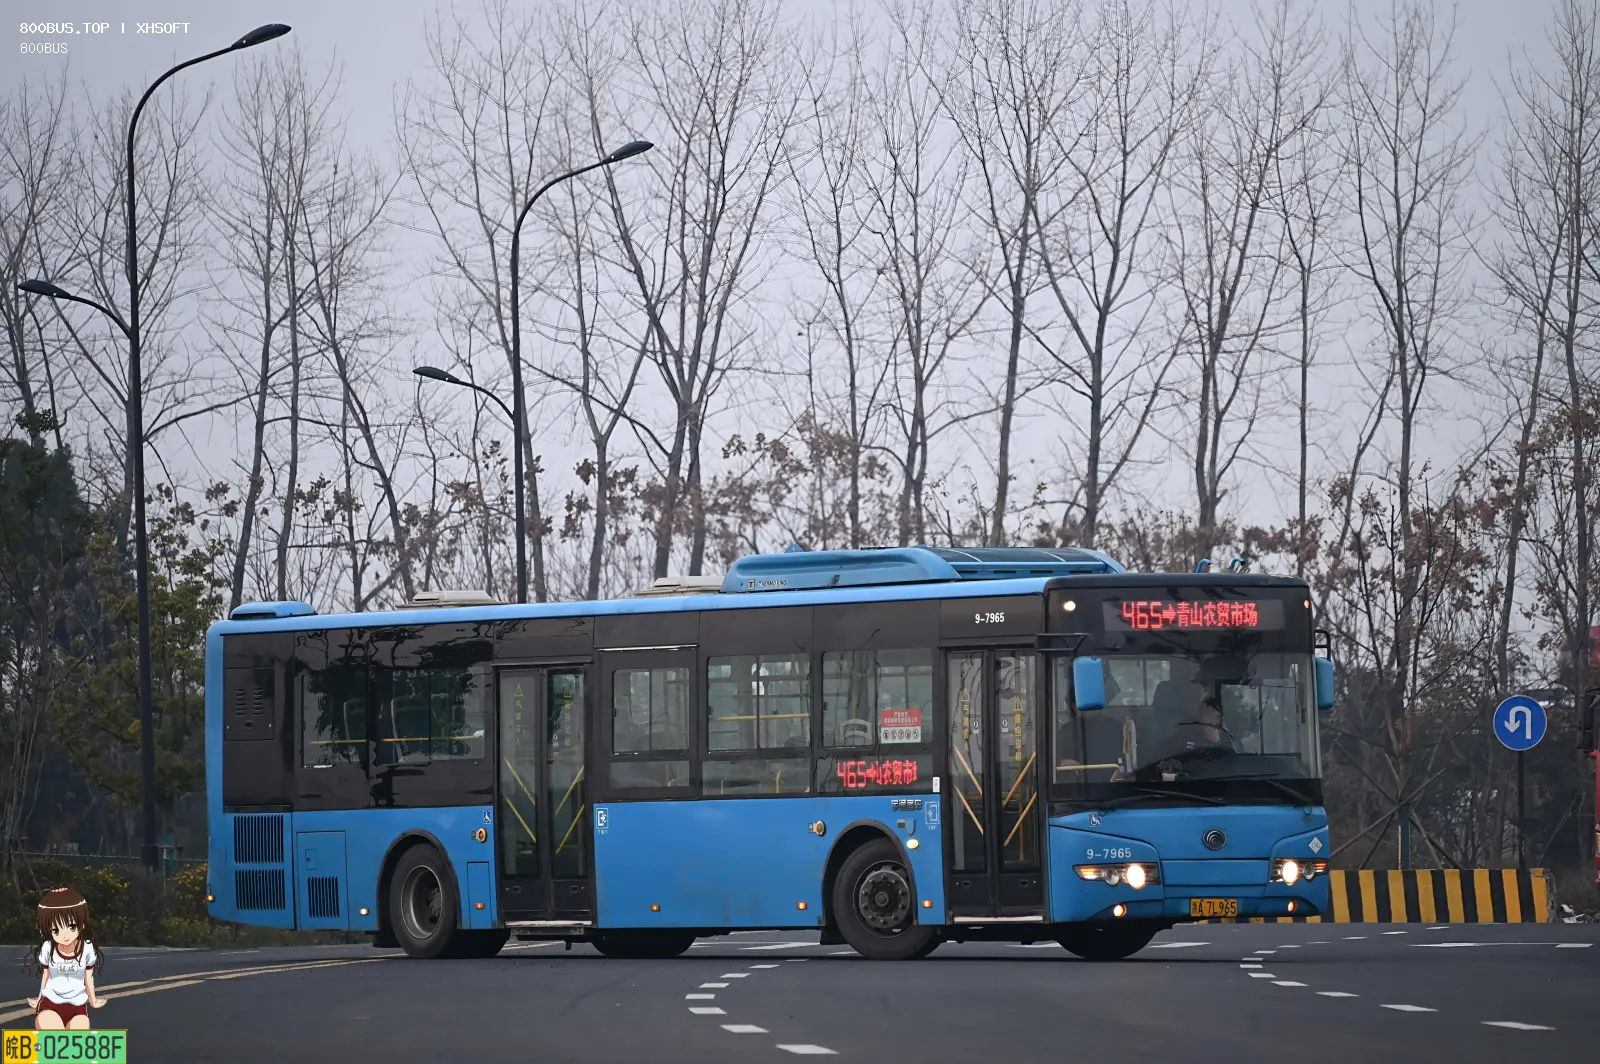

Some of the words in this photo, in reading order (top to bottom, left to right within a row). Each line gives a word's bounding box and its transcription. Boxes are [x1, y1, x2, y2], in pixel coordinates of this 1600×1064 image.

[975, 612, 1005, 624] 9-7965
[1123, 601, 1162, 628] 465
[1177, 601, 1258, 627] 青山农贸市场
[837, 760, 867, 788] 465
[1086, 847, 1132, 860] 9-7965
